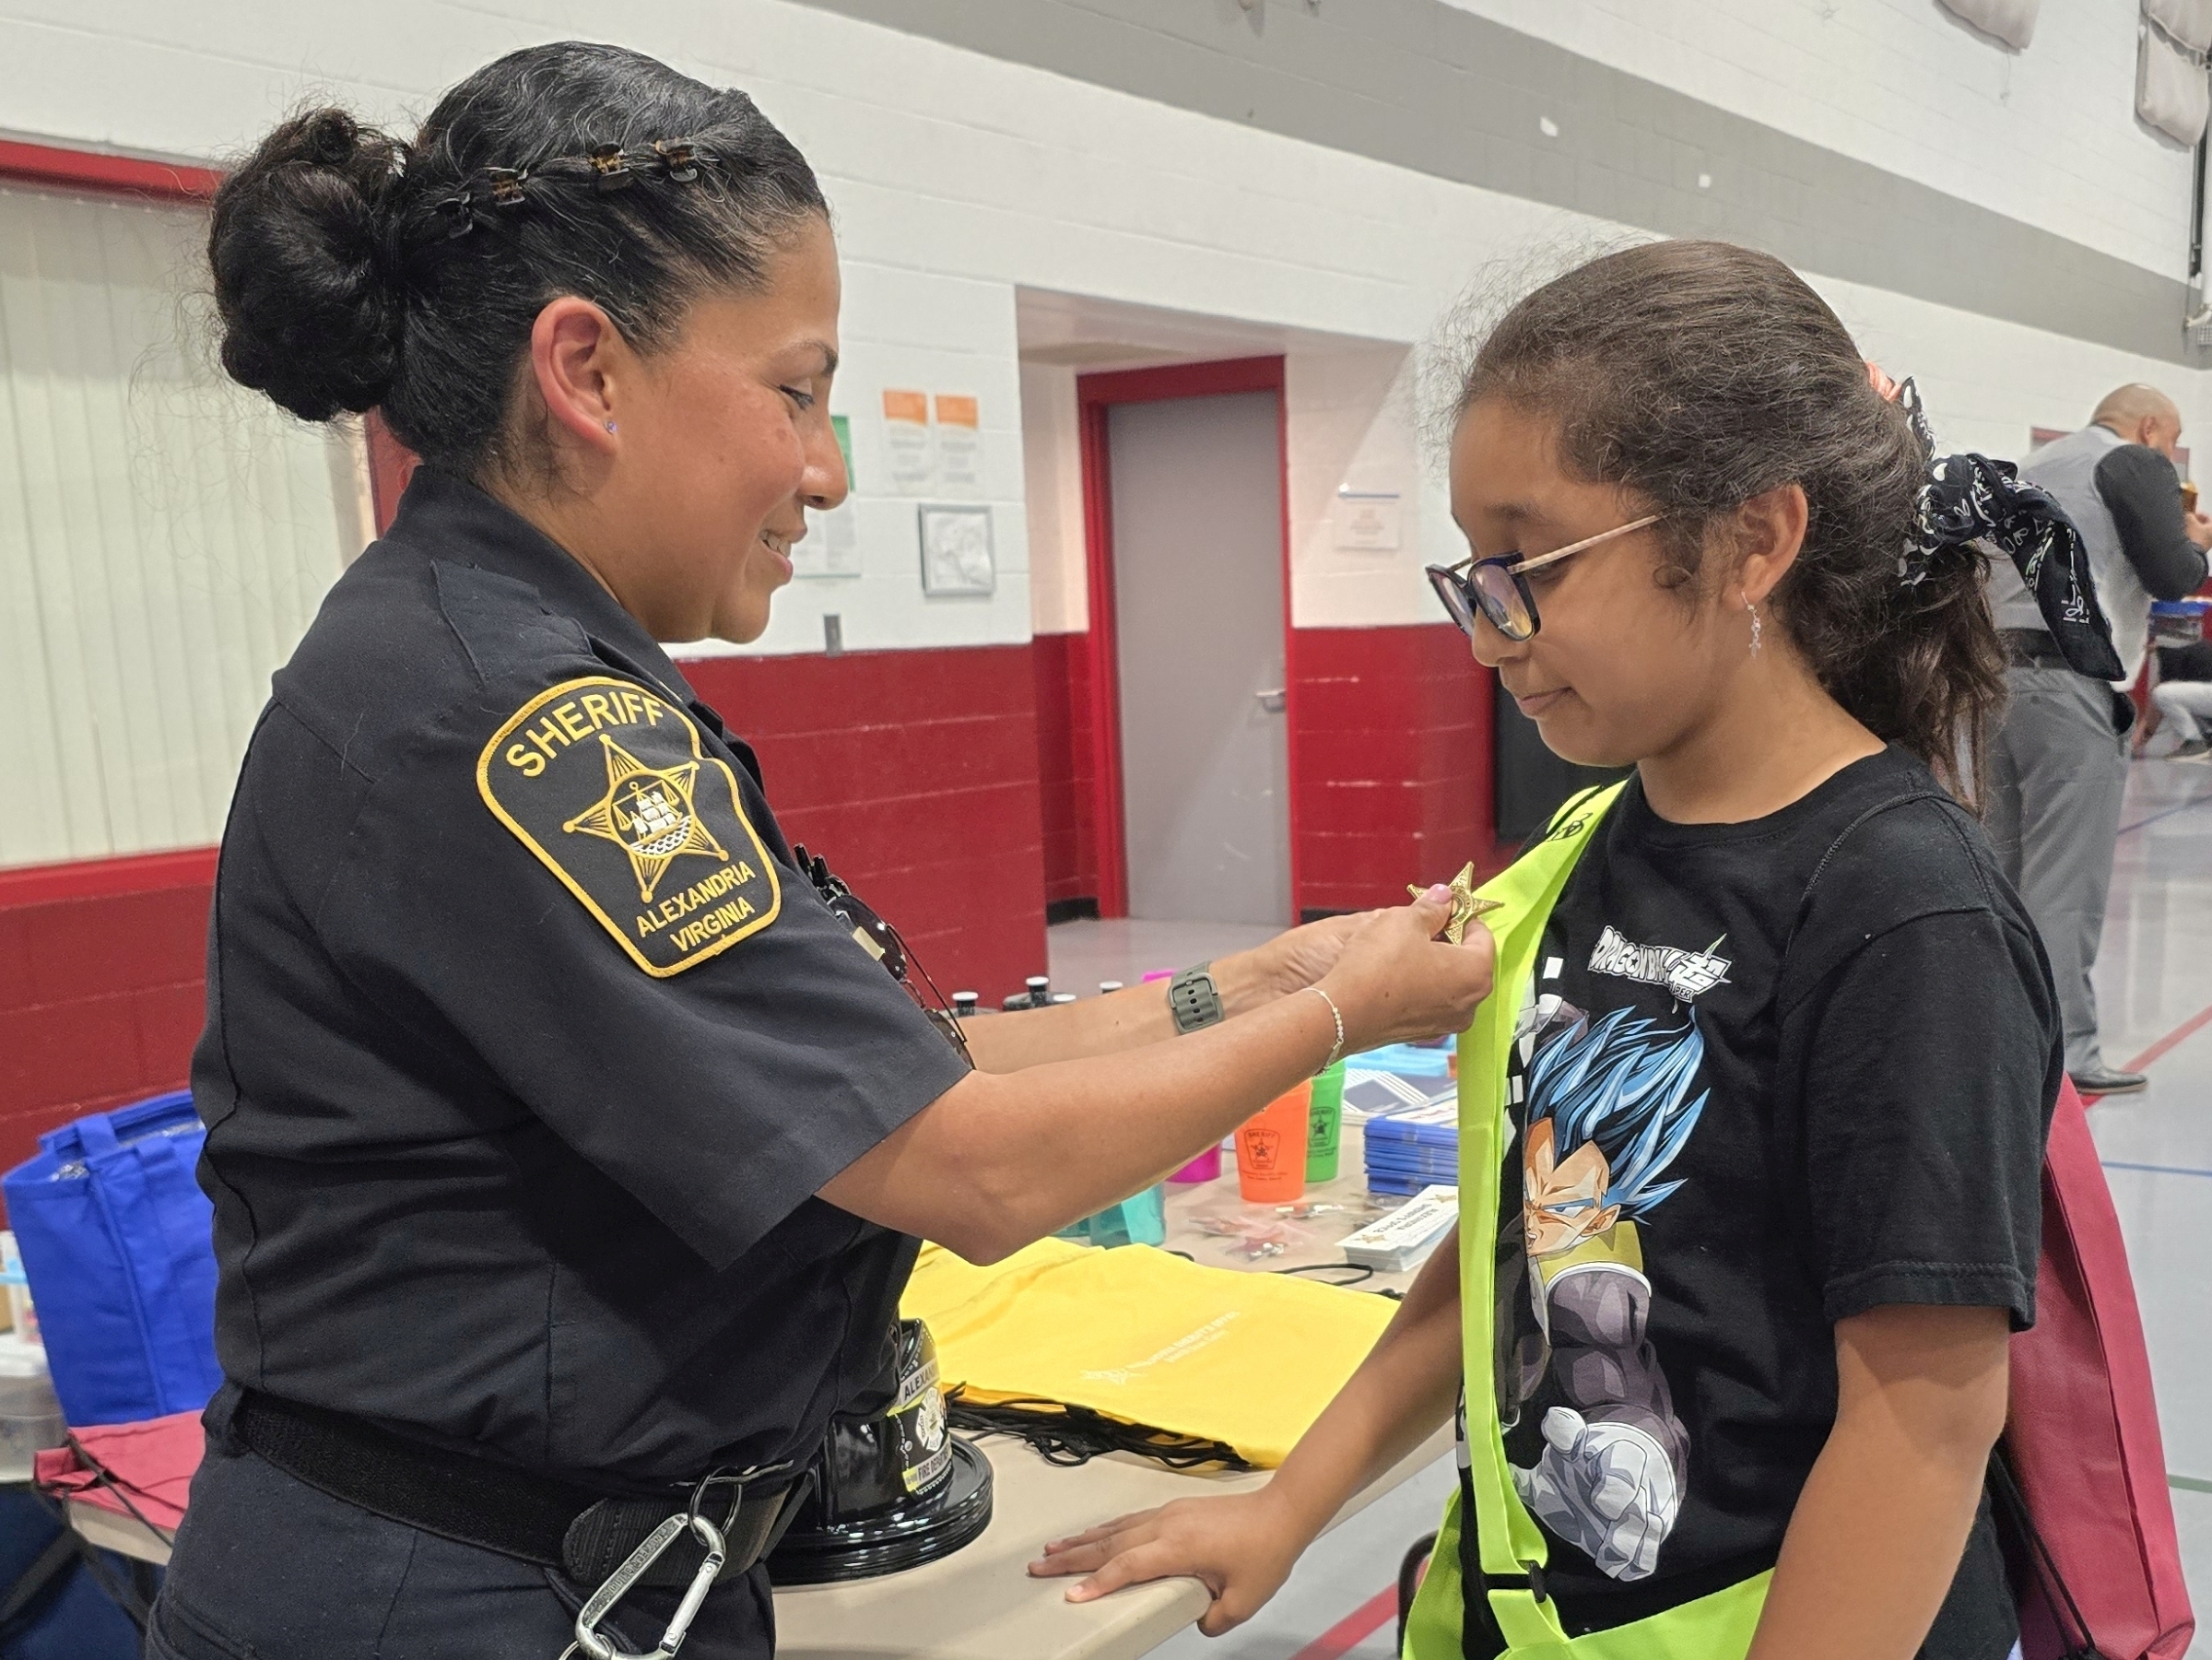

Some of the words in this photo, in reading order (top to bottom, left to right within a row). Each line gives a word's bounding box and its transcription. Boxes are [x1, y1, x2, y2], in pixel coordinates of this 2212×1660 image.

[506, 691, 664, 778] SHERIFF
[636, 861, 757, 938] ALEXANDRIA
[670, 897, 756, 952] VIRGINIA
[904, 1363, 938, 1401] ALEXAN
